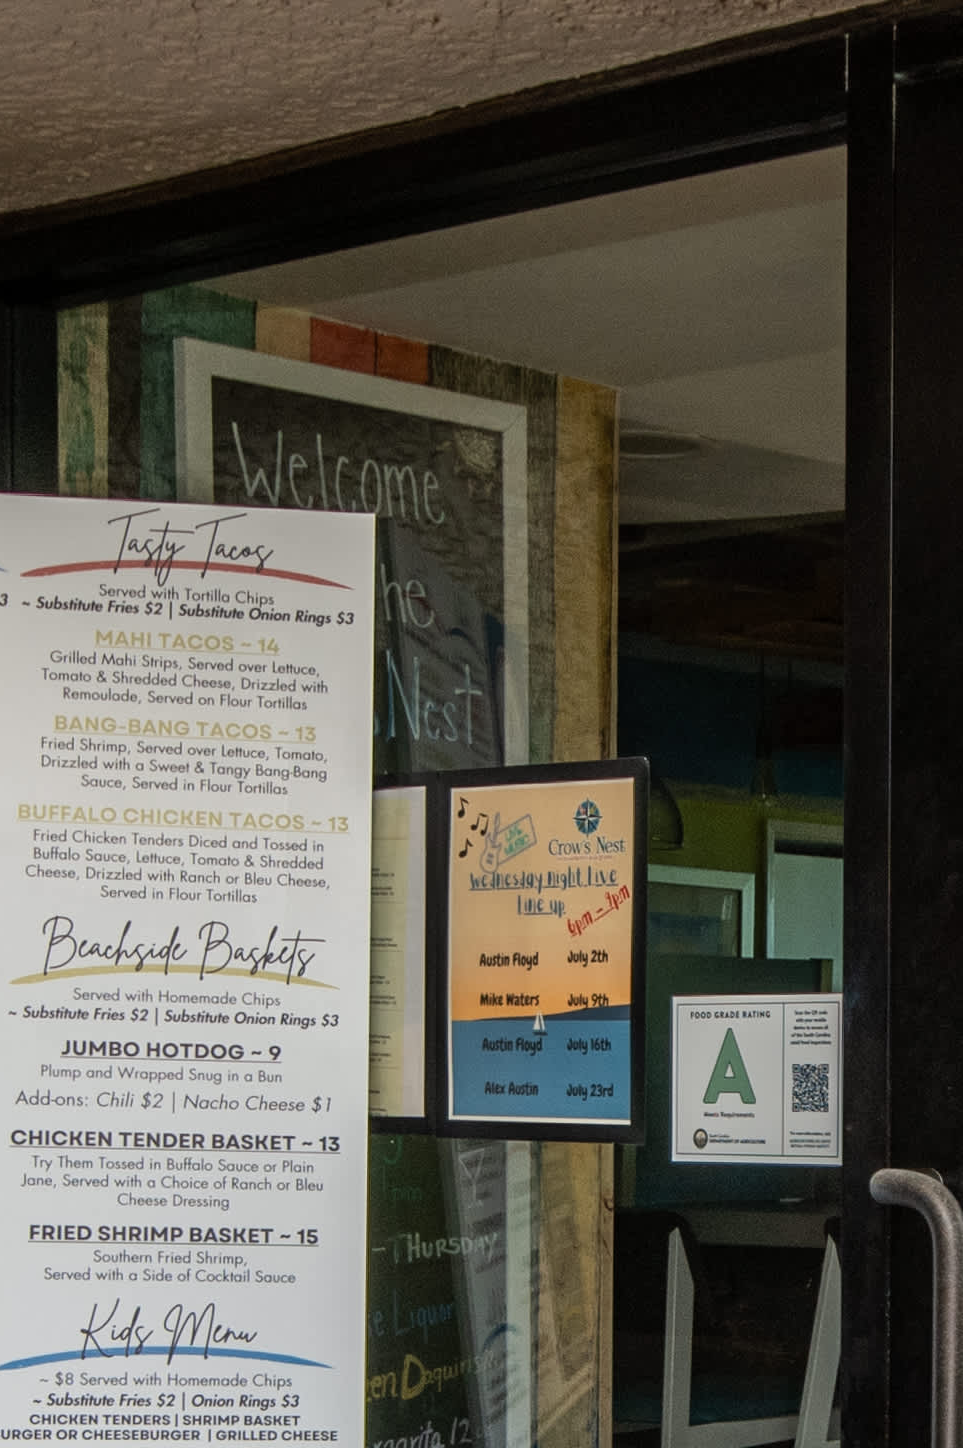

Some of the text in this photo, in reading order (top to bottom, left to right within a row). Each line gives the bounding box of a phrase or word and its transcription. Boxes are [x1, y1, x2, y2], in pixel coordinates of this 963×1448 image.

[231, 421, 445, 525] Welcome
[108, 508, 274, 587] Tasty Tacos
[95, 630, 152, 648] MAHI
[158, 634, 234, 652] TACOS
[258, 638, 280, 654] 14
[385, 648, 483, 745] Nest
[548, 839, 591, 856] Crow's
[597, 837, 626, 853] Nest
[42, 915, 326, 985] Beachside Baskets
[568, 950, 608, 968] July 2th
[480, 952, 539, 971] Austin Floyd
[480, 993, 539, 1006] Mike Waters
[568, 994, 609, 1008] July 9th
[690, 1011, 771, 1019] FOOD GRADE RATING
[482, 1038, 542, 1056] Austin Floyd
[567, 1038, 611, 1054] July 16th
[703, 1028, 756, 1104] A
[485, 1081, 538, 1096] Alex Austin
[567, 1084, 613, 1101] July 23rd
[29, 1225, 92, 1241] FRIED
[98, 1226, 183, 1243] SHRIMP
[189, 1228, 274, 1244] BASKET
[296, 1229, 318, 1245] 15
[80, 1298, 257, 1365] Kids Menu
